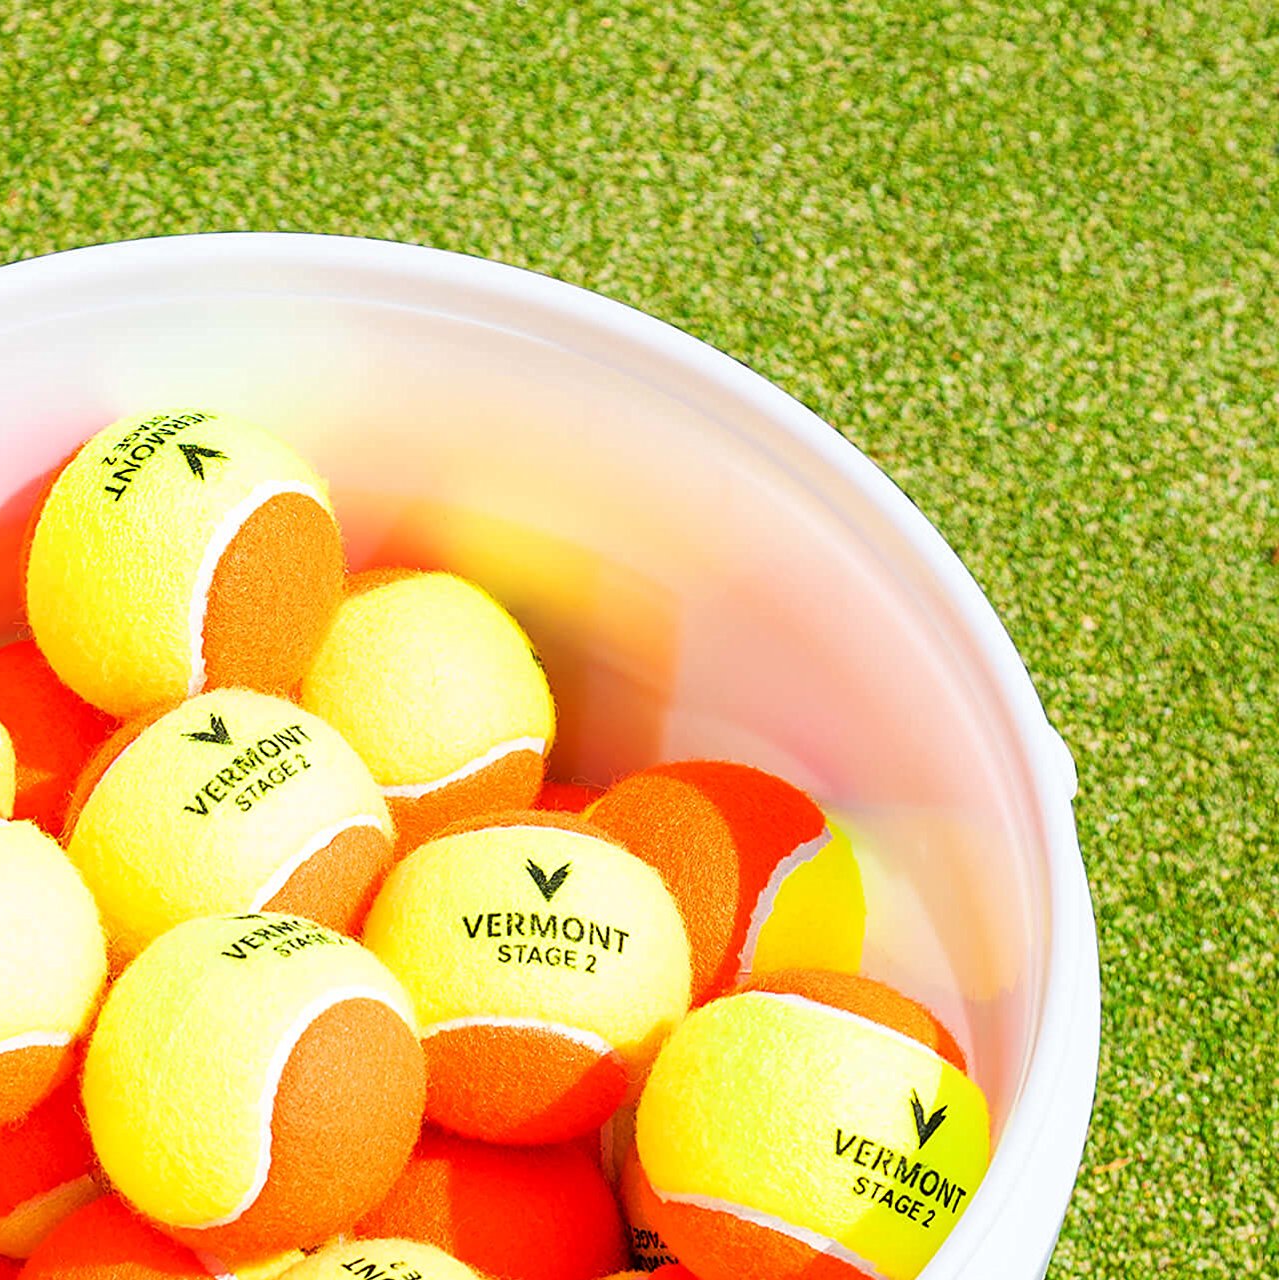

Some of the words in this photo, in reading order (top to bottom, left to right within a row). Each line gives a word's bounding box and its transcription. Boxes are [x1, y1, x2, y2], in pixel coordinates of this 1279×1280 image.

[101, 456, 118, 466] 2
[184, 725, 312, 816] VERMONT
[235, 759, 298, 812] STAGE
[295, 753, 312, 769] 2
[462, 912, 629, 954] VERMONT
[498, 944, 577, 969] STAGE
[585, 954, 597, 973] 2
[834, 1128, 967, 1214] VERMONT
[853, 1176, 925, 1221] STAGE
[921, 1209, 937, 1228] 2
